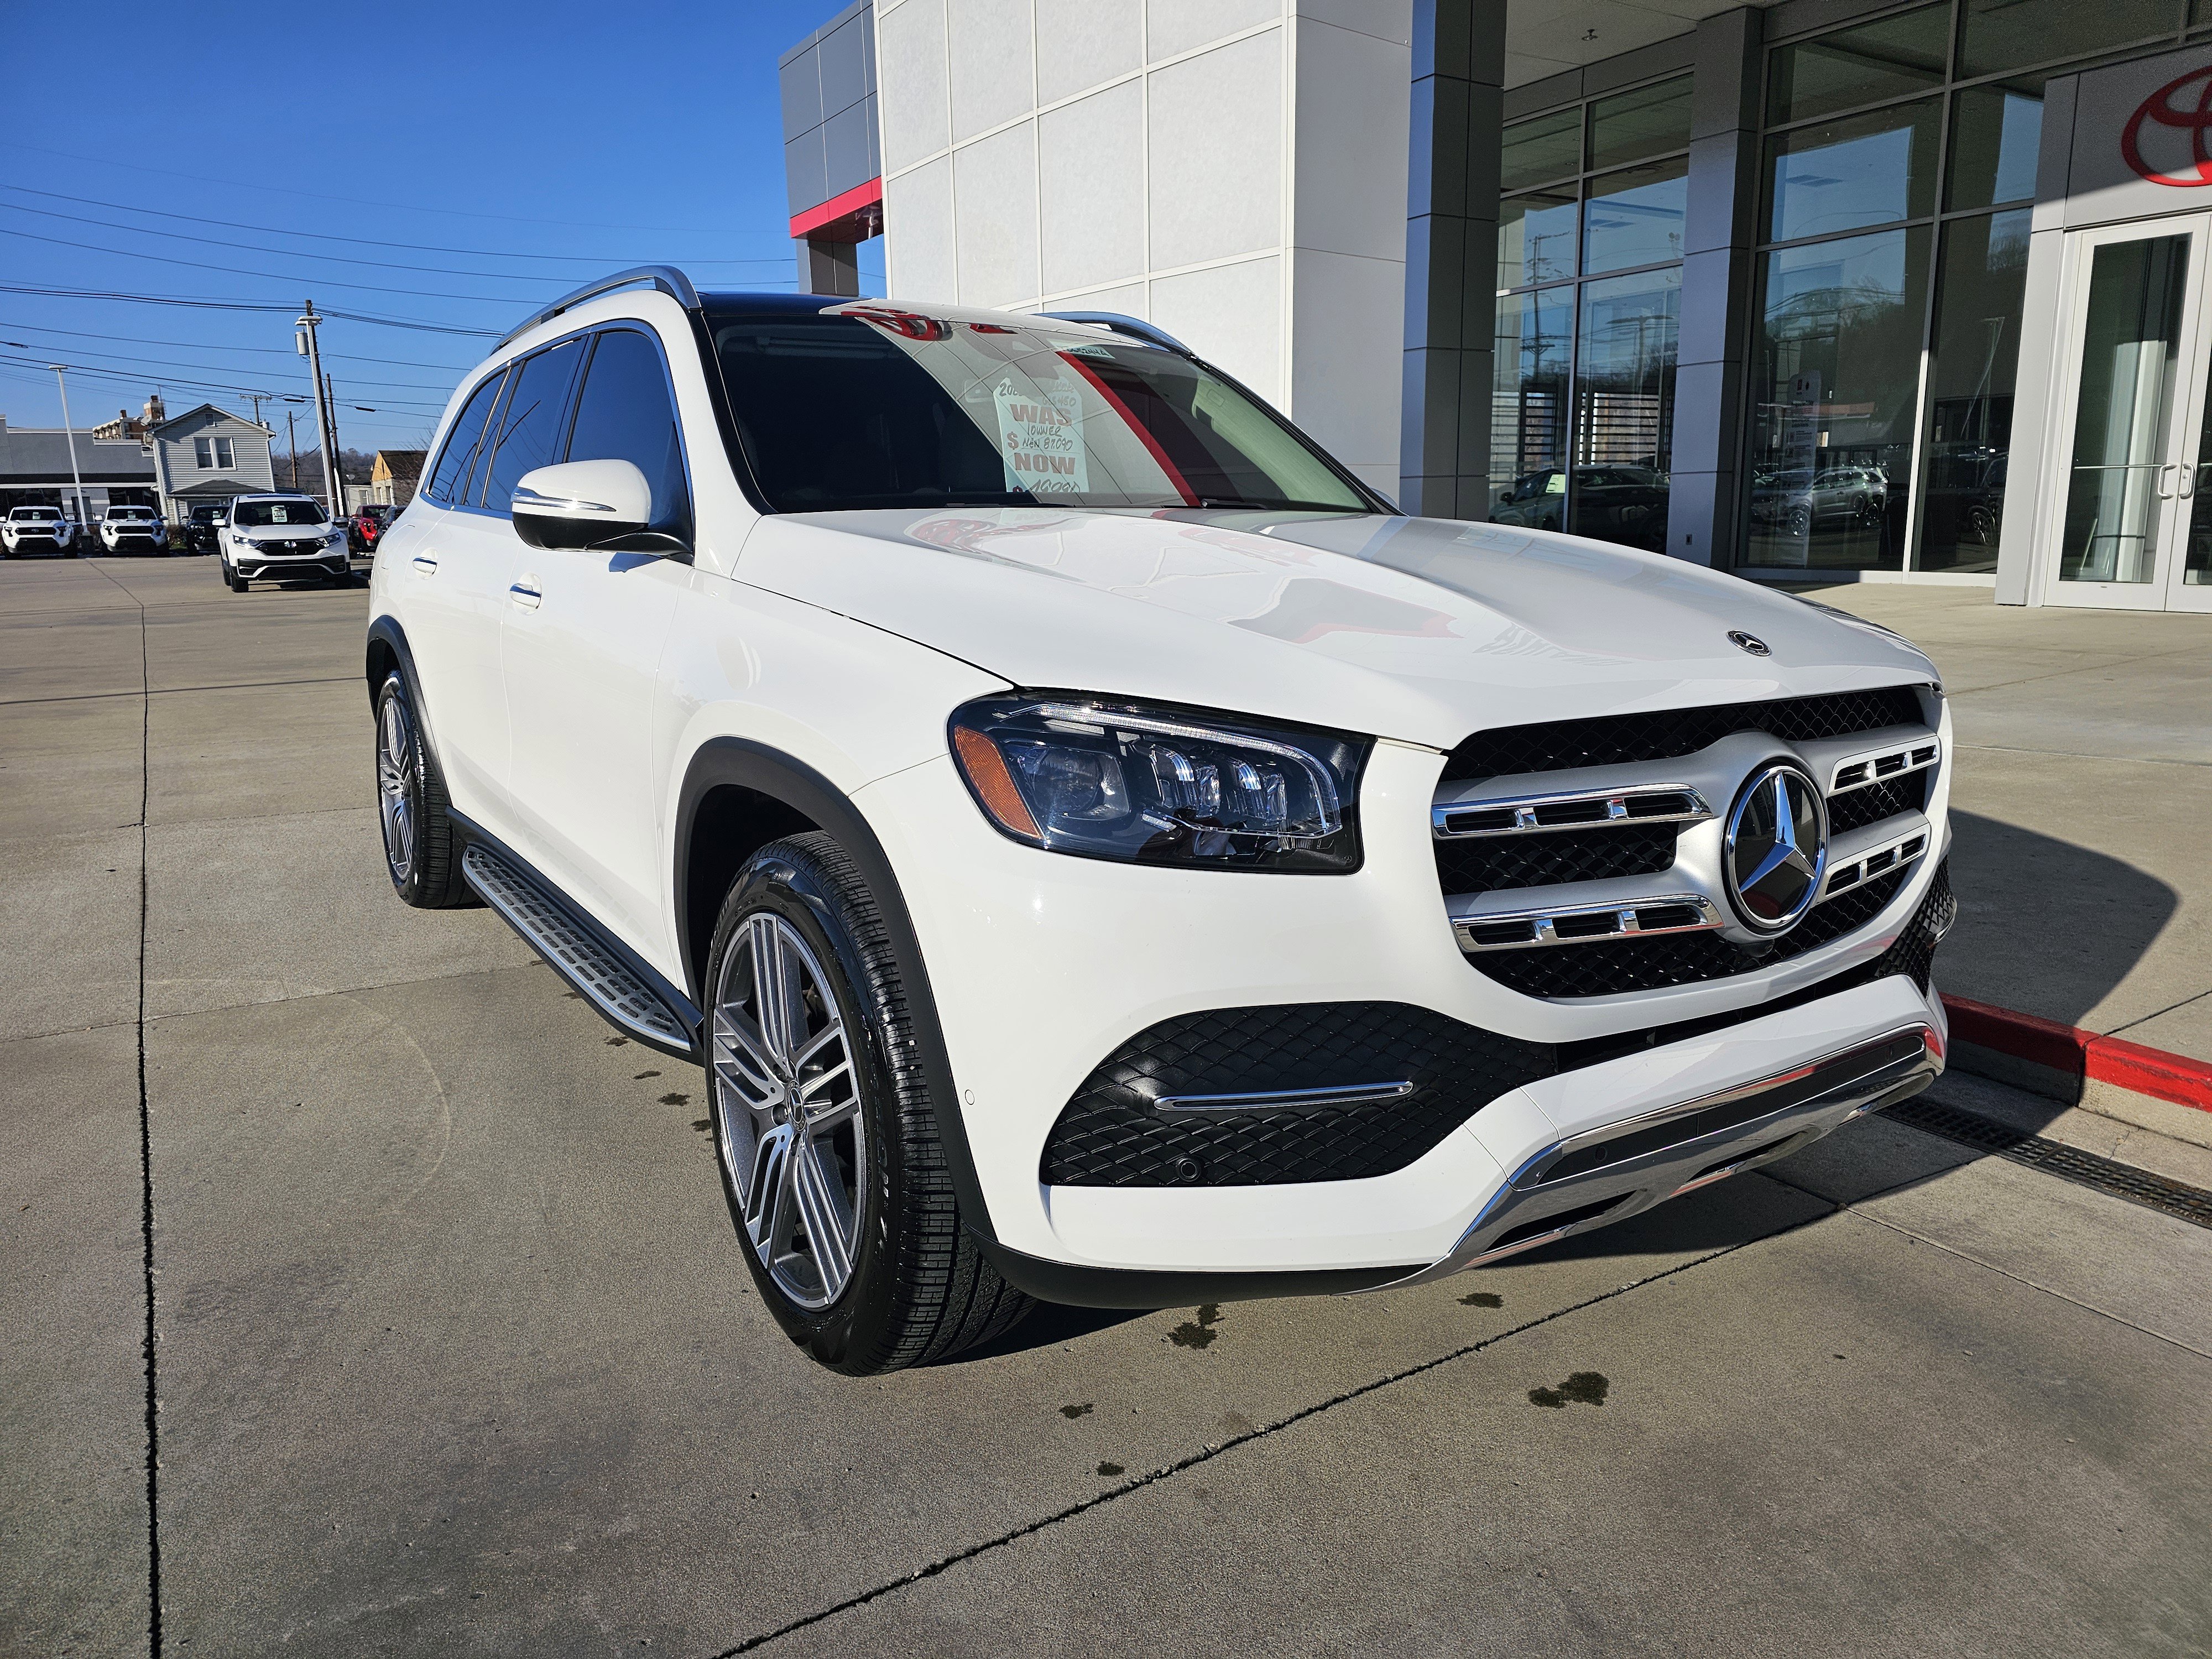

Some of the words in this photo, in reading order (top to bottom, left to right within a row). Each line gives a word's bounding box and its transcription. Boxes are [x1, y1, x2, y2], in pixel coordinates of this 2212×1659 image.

[1010, 404, 1072, 426] WAS
[1006, 431, 1019, 450] $
[1014, 452, 1076, 475] NOW
